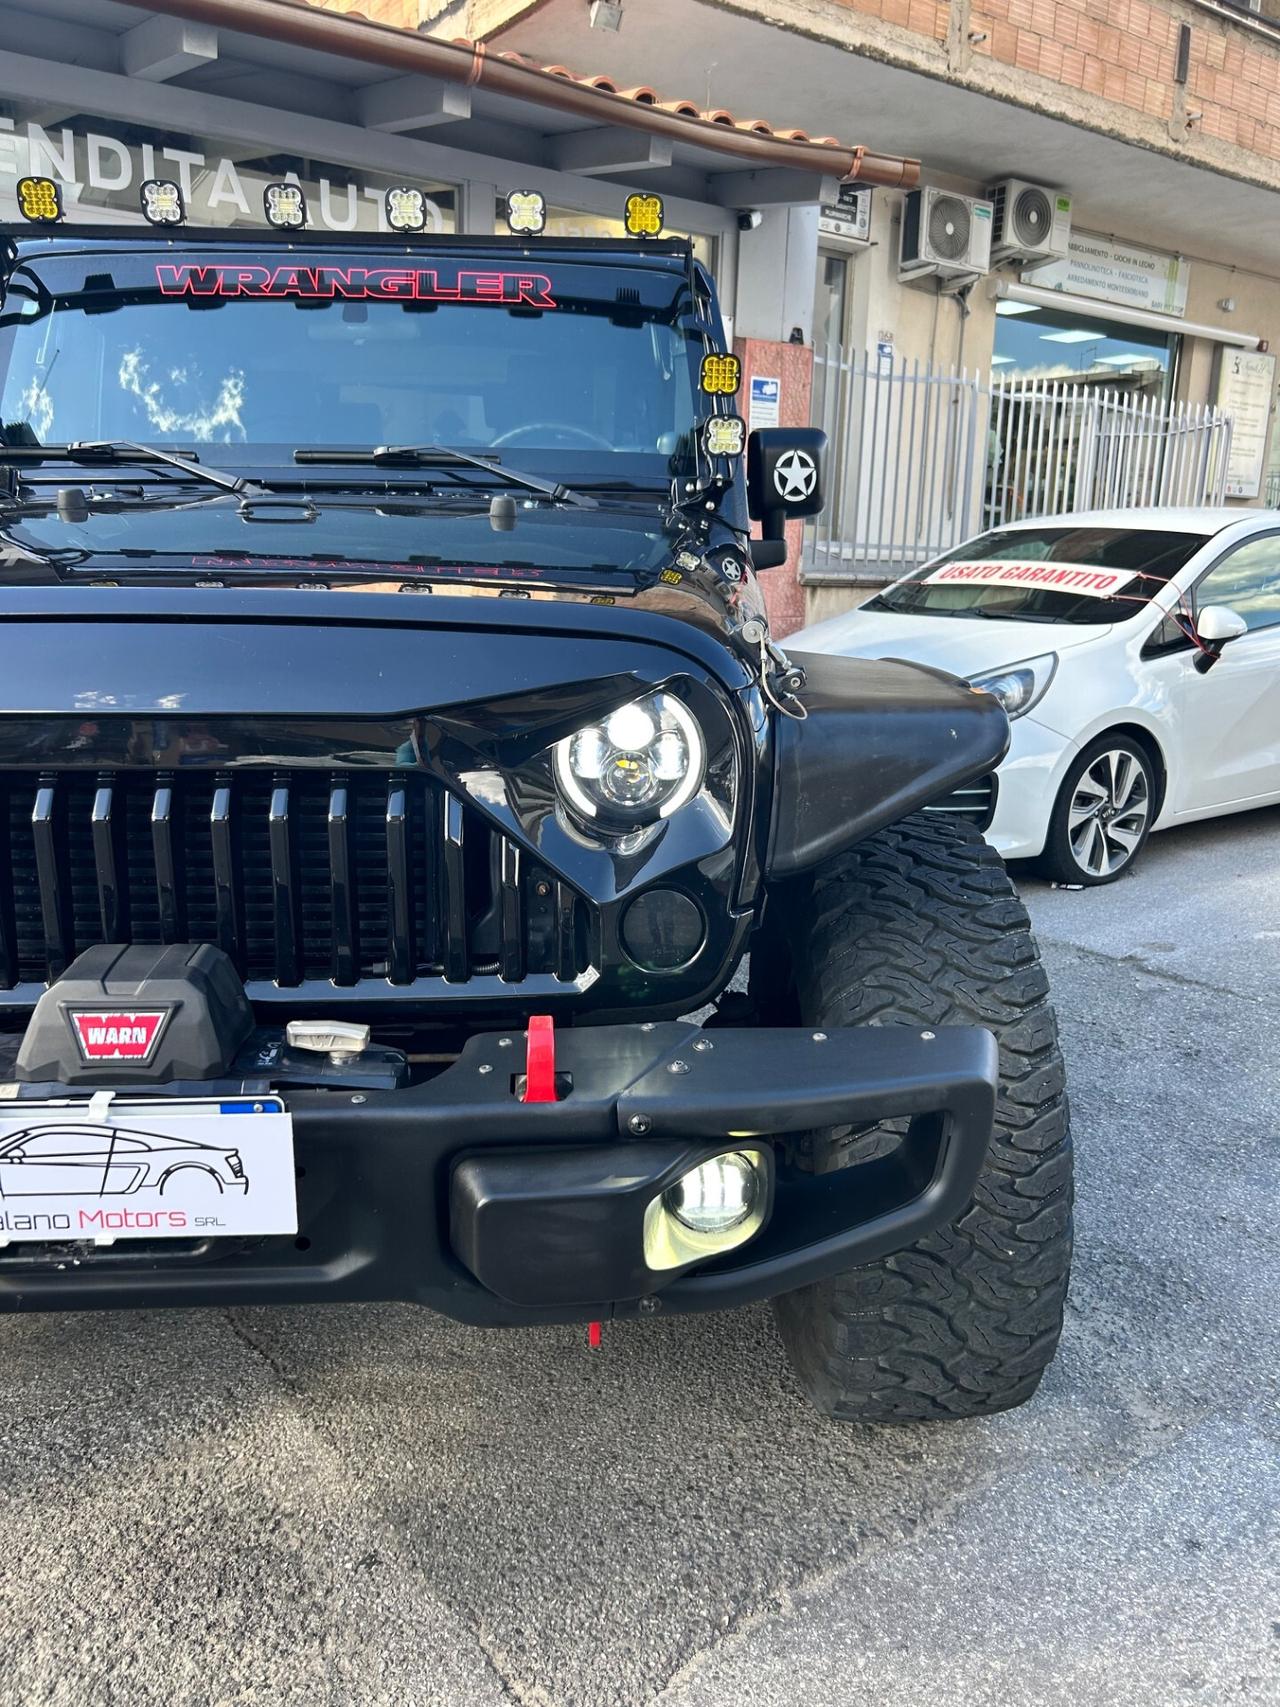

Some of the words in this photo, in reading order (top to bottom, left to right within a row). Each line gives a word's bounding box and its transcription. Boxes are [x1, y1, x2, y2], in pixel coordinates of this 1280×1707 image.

[1138, 260, 1156, 270] LEGNO
[156, 265, 557, 307] WRANGLER
[938, 565, 1002, 580] USATO
[999, 566, 1119, 590] GARANTITO
[87, 1026, 147, 1045] WARN
[0, 1210, 71, 1231] lano
[78, 1207, 187, 1229] Motors
[194, 1216, 226, 1227] SRL
